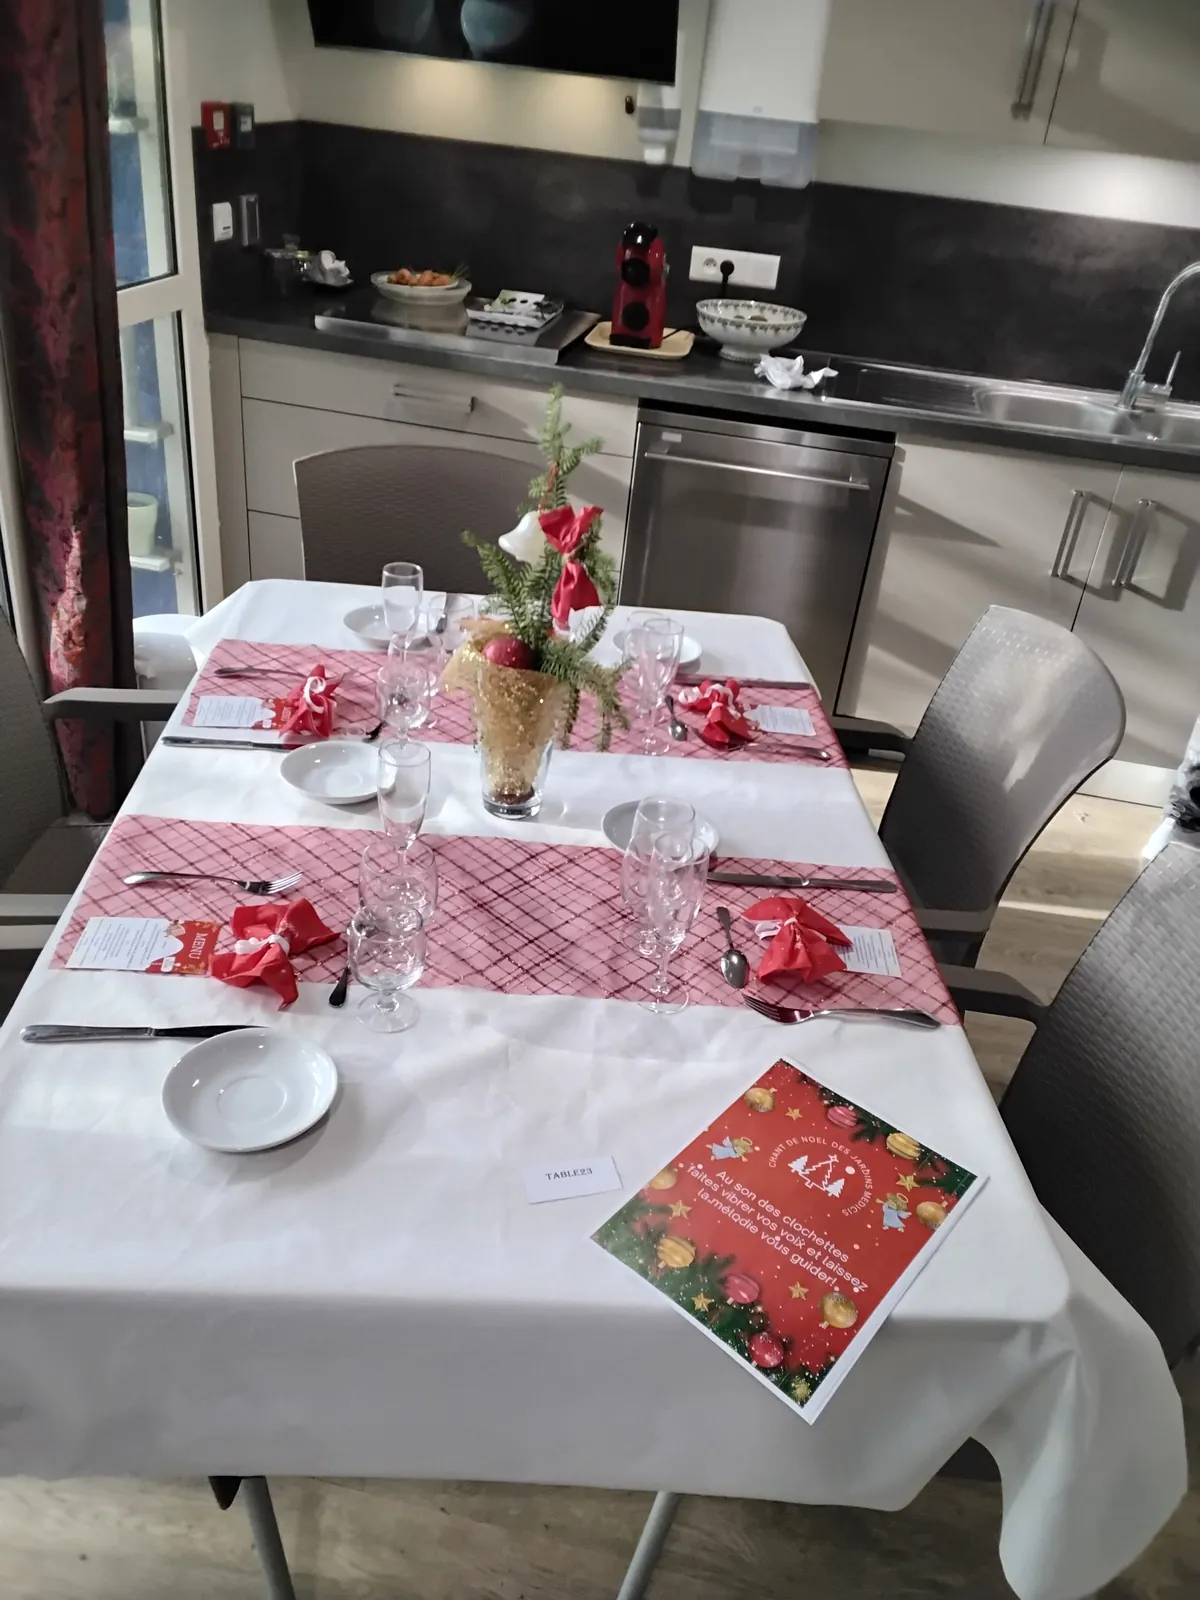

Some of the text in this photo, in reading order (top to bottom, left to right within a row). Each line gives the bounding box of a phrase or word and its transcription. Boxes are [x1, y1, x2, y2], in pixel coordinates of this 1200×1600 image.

[188, 932, 208, 959] MENU
[716, 1171, 849, 1263] Au son des clochettes
[768, 1136, 873, 1217] CHANT DE NOEL DES JARDINS MEDICIS
[687, 1165, 868, 1292] faites vibrer vos voix et laissez
[697, 1188, 838, 1287] la mélodie vous guider!
